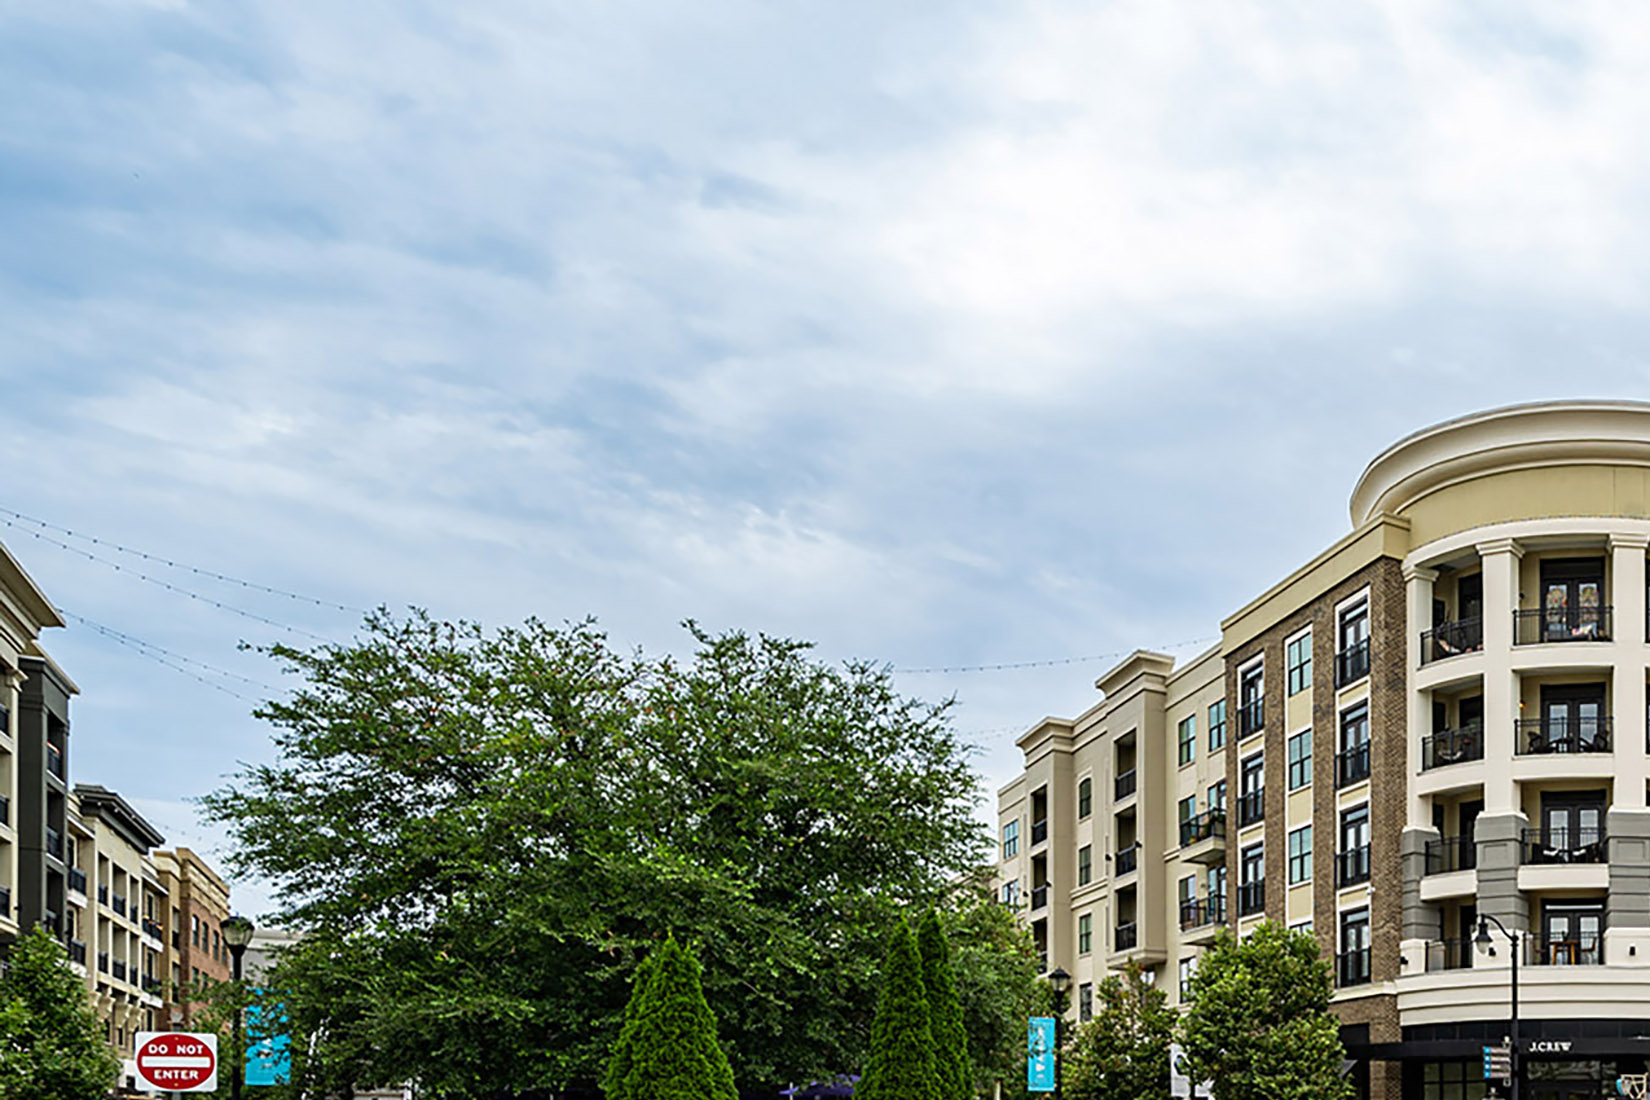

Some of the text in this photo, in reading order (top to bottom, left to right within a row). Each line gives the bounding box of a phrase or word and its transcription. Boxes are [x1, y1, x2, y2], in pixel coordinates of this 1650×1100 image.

[148, 1044, 204, 1055] DO NOT
[153, 1069, 199, 1080] ENTER
